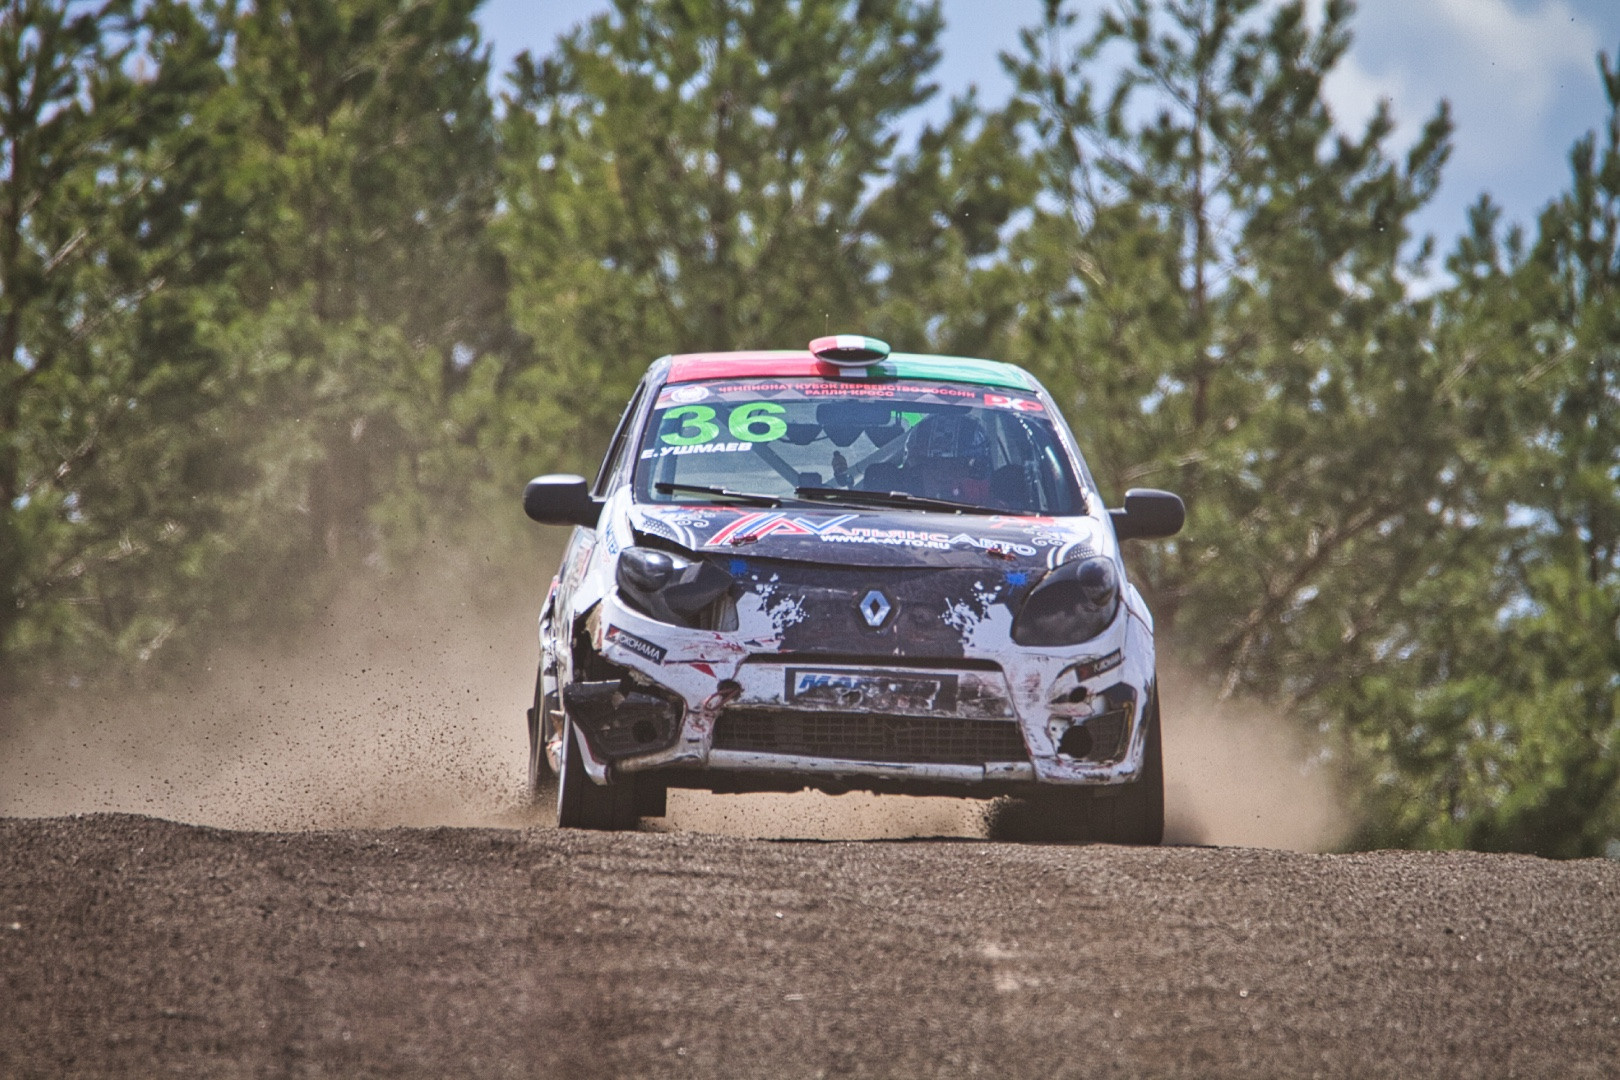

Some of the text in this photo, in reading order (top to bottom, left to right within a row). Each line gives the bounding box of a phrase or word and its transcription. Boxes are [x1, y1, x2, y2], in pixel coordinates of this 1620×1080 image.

[718, 383, 793, 393] ЧЕМПИОНАТ
[840, 383, 920, 393] ПЕРВЕНСТВО
[660, 402, 788, 446] 36
[641, 442, 753, 459] Е.УШМАЕВ
